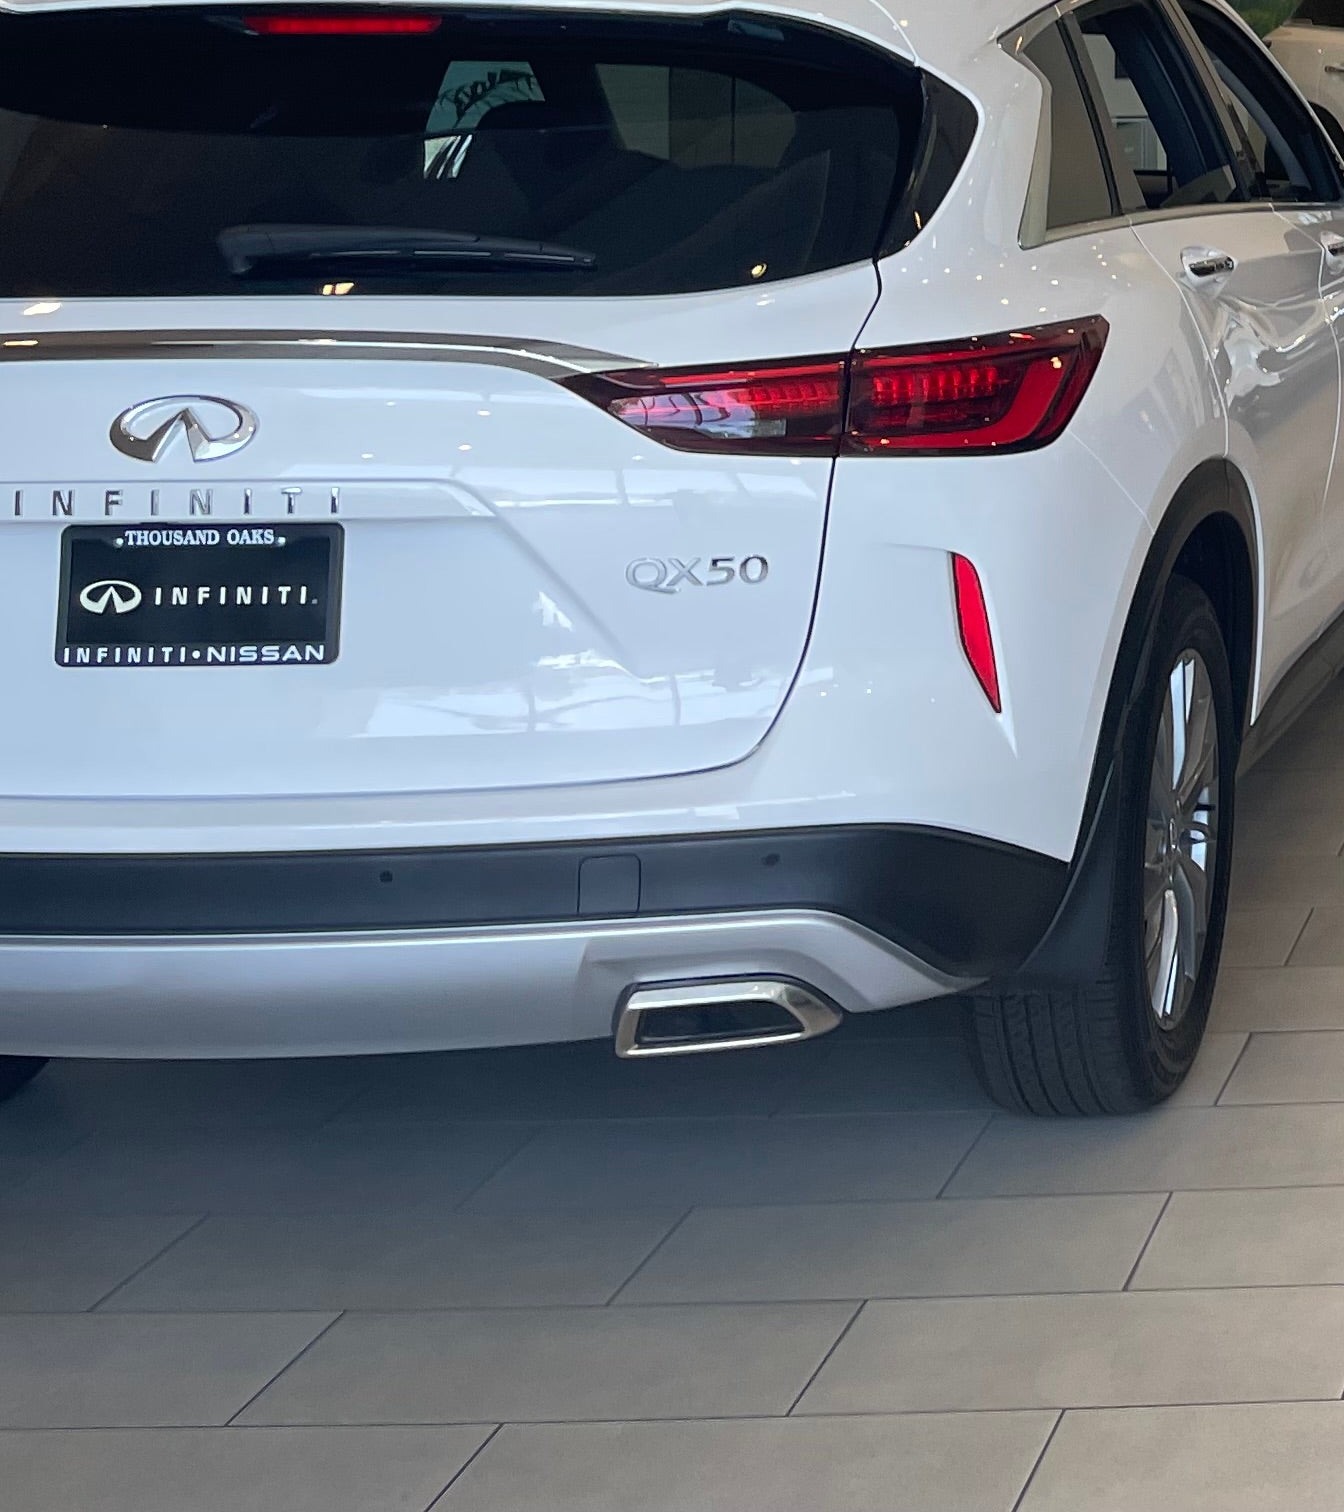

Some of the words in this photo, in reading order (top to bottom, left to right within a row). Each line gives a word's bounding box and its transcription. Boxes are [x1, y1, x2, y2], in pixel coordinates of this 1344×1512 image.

[13, 486, 340, 517] INFINITI
[124, 529, 220, 546] THOUSAND
[227, 529, 275, 545] OAKS
[625, 554, 769, 595] QX50
[155, 586, 308, 606] INFINITI
